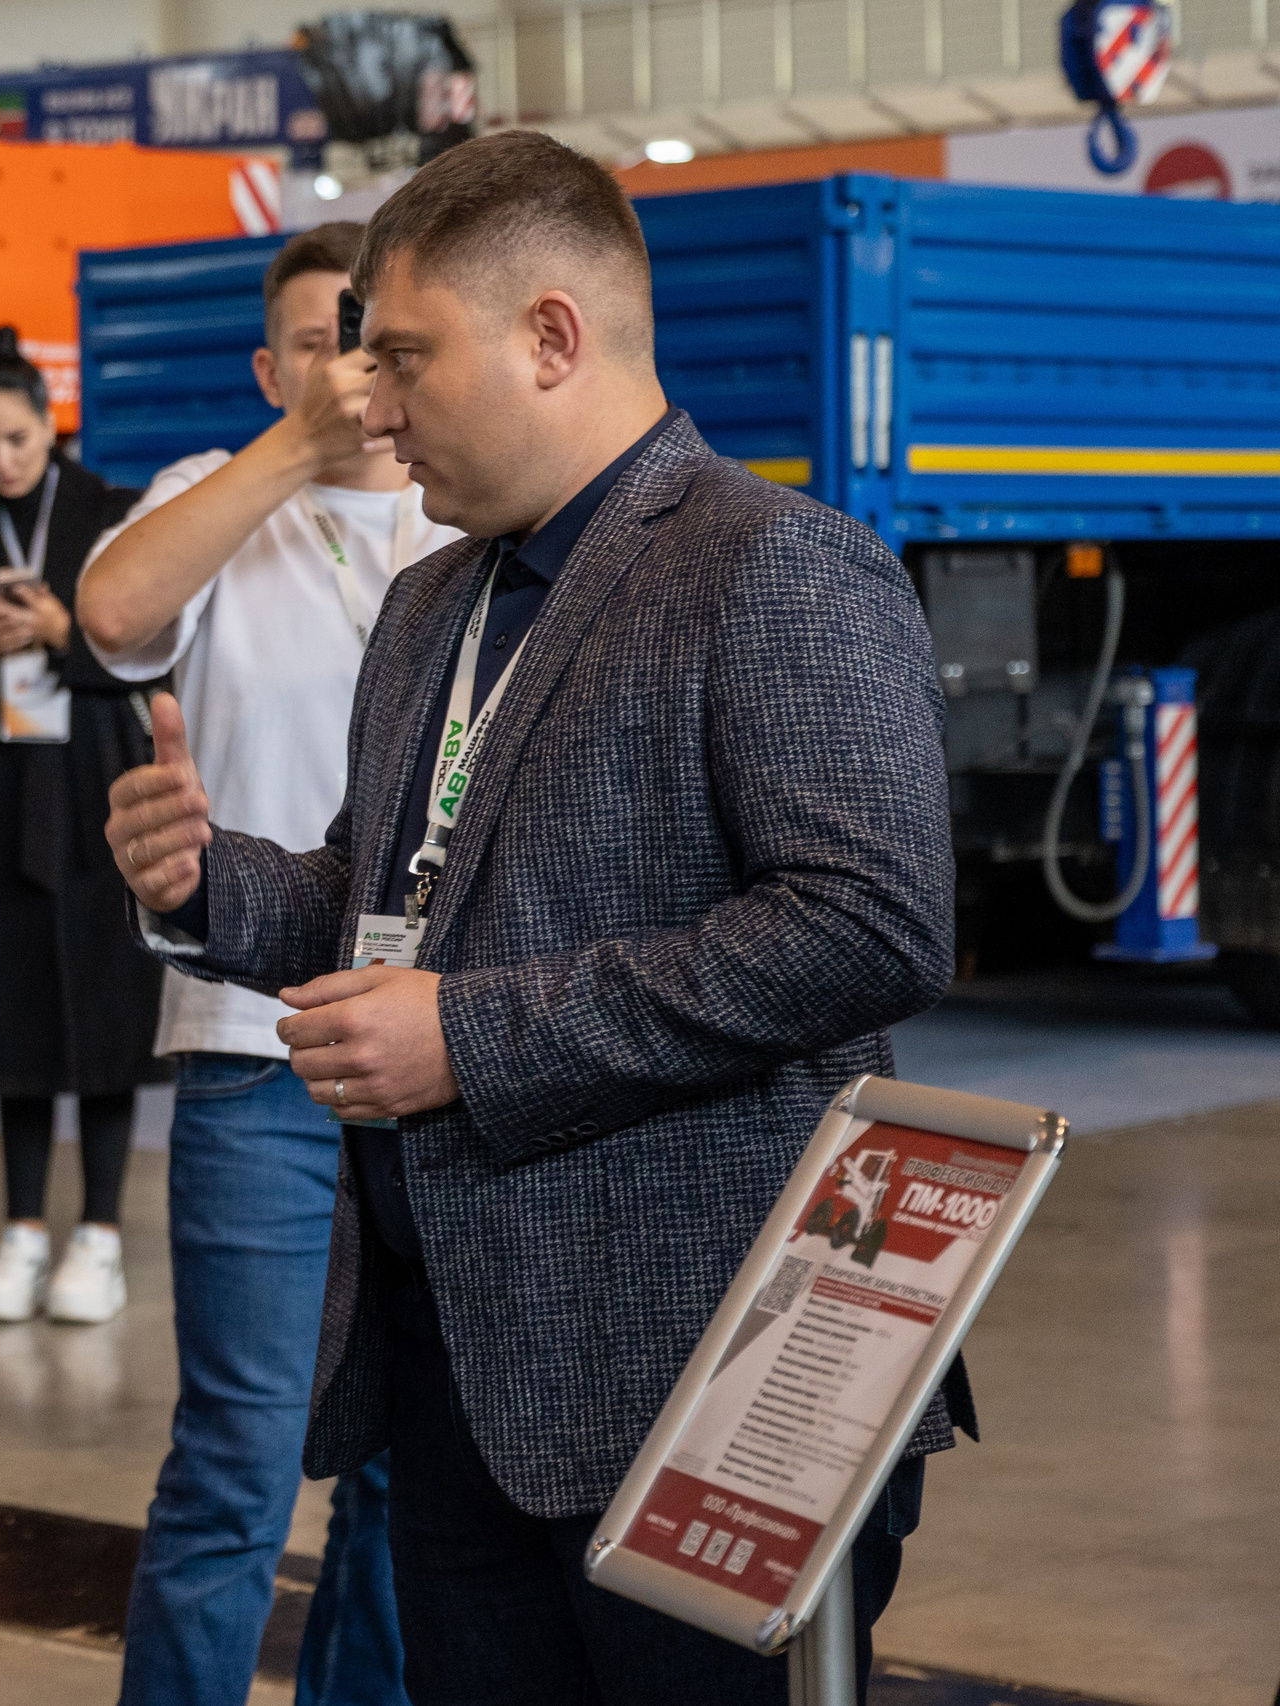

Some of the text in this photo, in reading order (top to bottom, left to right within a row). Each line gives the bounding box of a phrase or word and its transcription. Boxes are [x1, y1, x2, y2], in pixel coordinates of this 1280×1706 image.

[458, 710, 491, 770] МАШИНЫ
[902, 1157, 1014, 1196] ПРОФЕССИОНАЛ
[898, 1181, 1000, 1230] ПМ-1000
[702, 1494, 727, 1514] ООО
